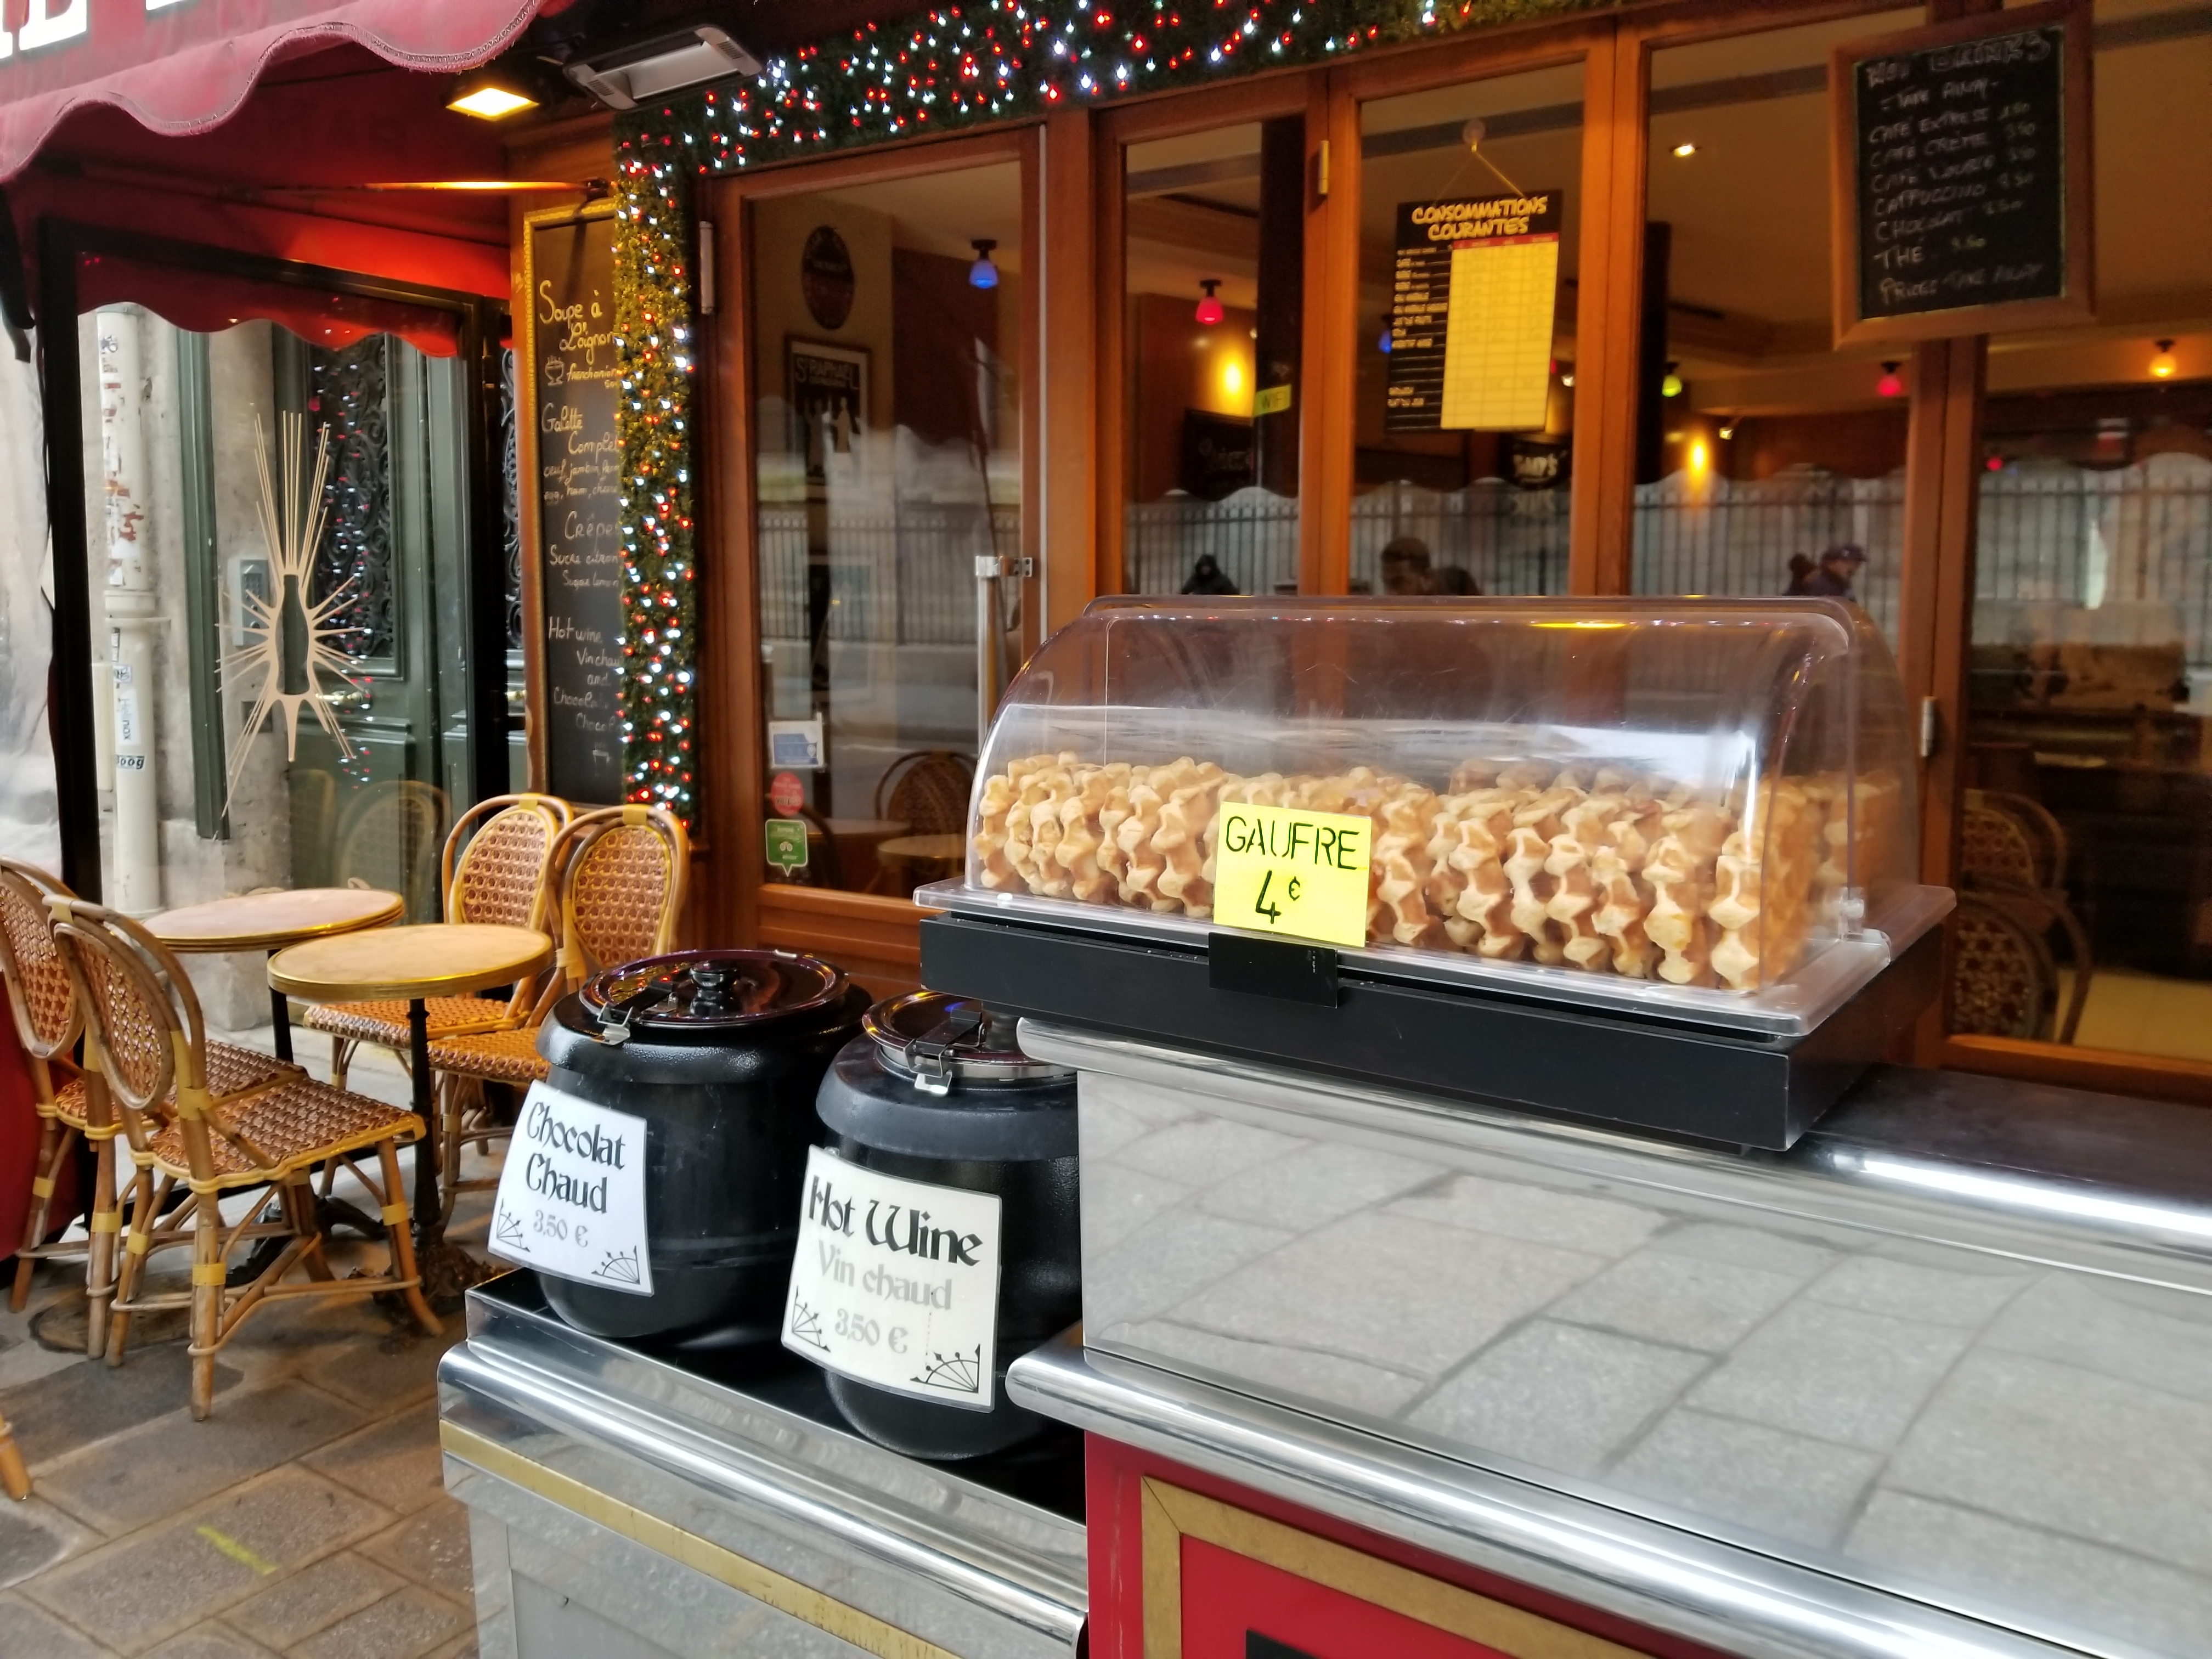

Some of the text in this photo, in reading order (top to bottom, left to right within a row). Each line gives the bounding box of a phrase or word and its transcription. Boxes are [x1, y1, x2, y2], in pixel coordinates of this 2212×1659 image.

[1412, 196, 1548, 224] CONSOMMATIONS
[1428, 217, 1530, 241] COURANTES
[540, 280, 584, 330] Soupe
[541, 402, 583, 433] Galette
[568, 430, 620, 465] Complet
[549, 616, 575, 640] Hot
[595, 648, 621, 667] chau
[1226, 815, 1360, 870] GAUFRE
[527, 1102, 625, 1170] Chocolat
[526, 1153, 608, 1214] Chaud
[809, 1175, 984, 1267] Hot Wine
[819, 1240, 952, 1310] Vin chaud
[888, 1327, 909, 1354] €
